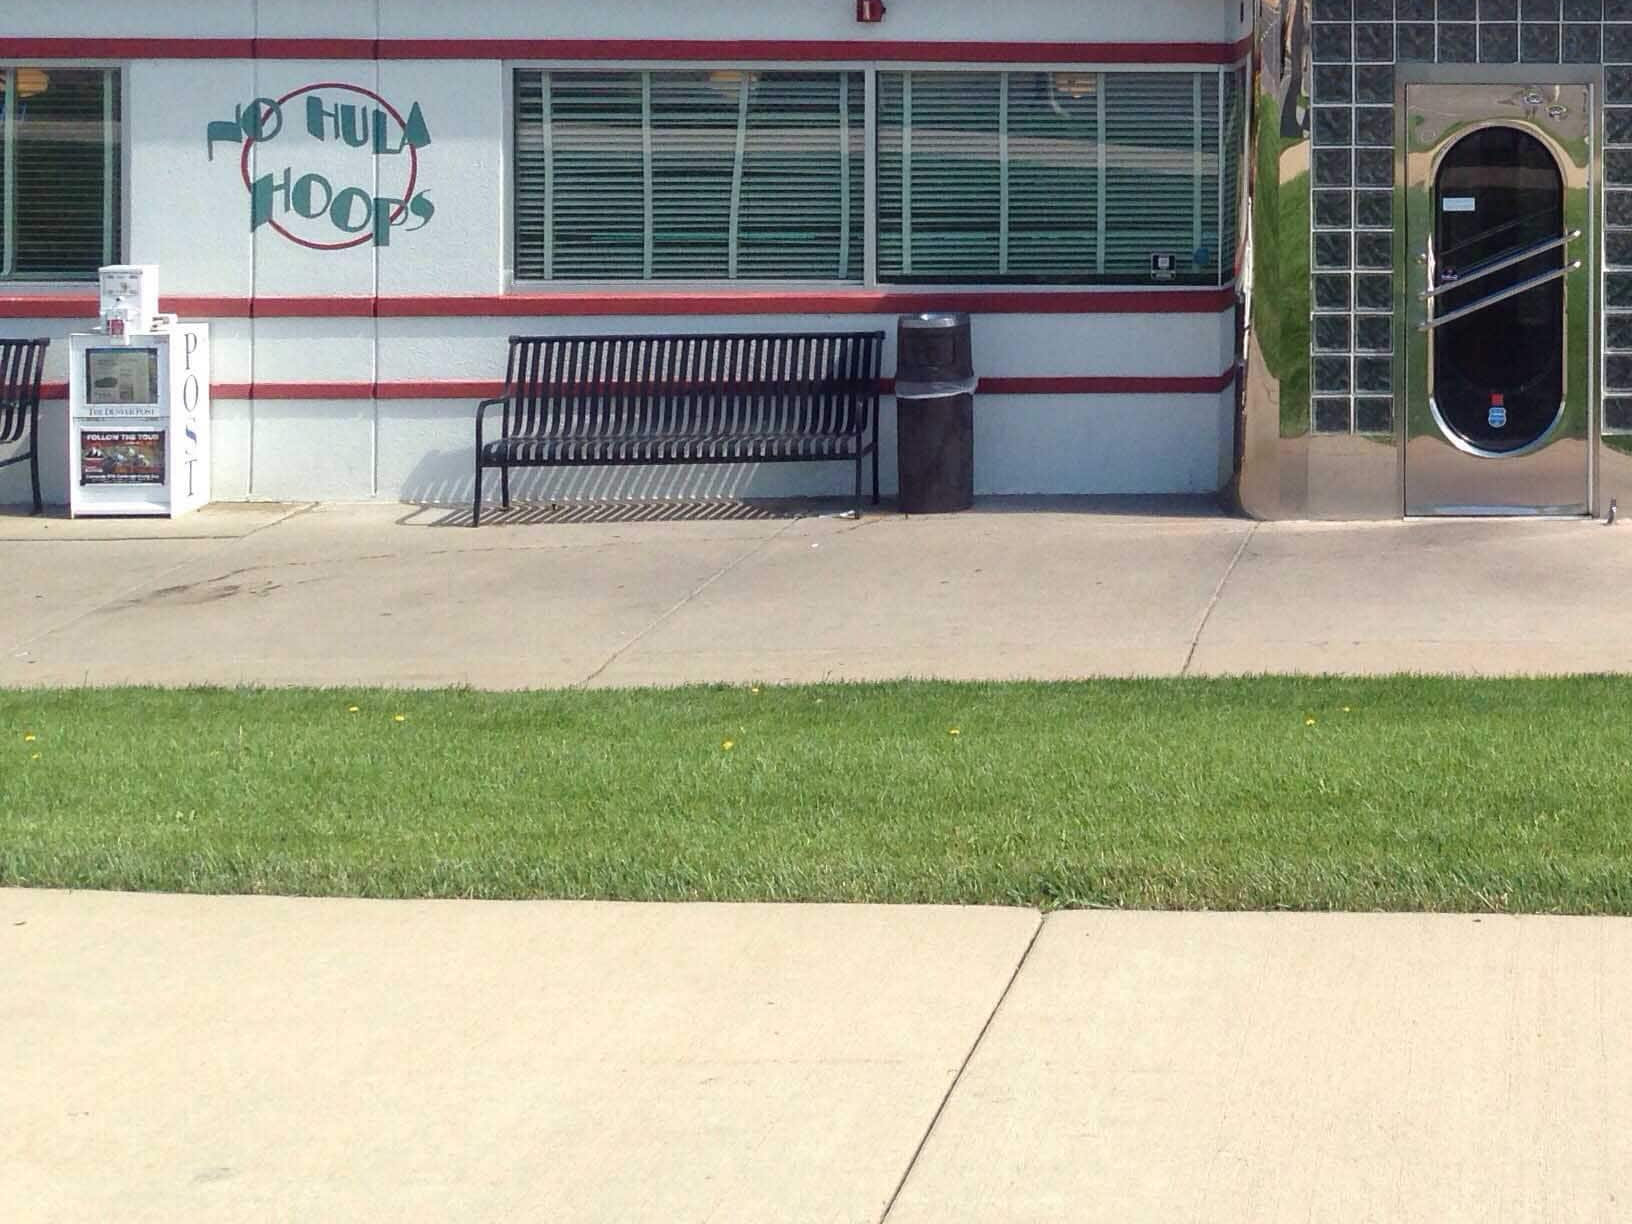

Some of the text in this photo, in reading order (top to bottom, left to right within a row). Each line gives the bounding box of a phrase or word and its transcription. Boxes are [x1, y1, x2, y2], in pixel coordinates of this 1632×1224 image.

[207, 95, 432, 161] NO HULA
[251, 167, 435, 247] HOOPS
